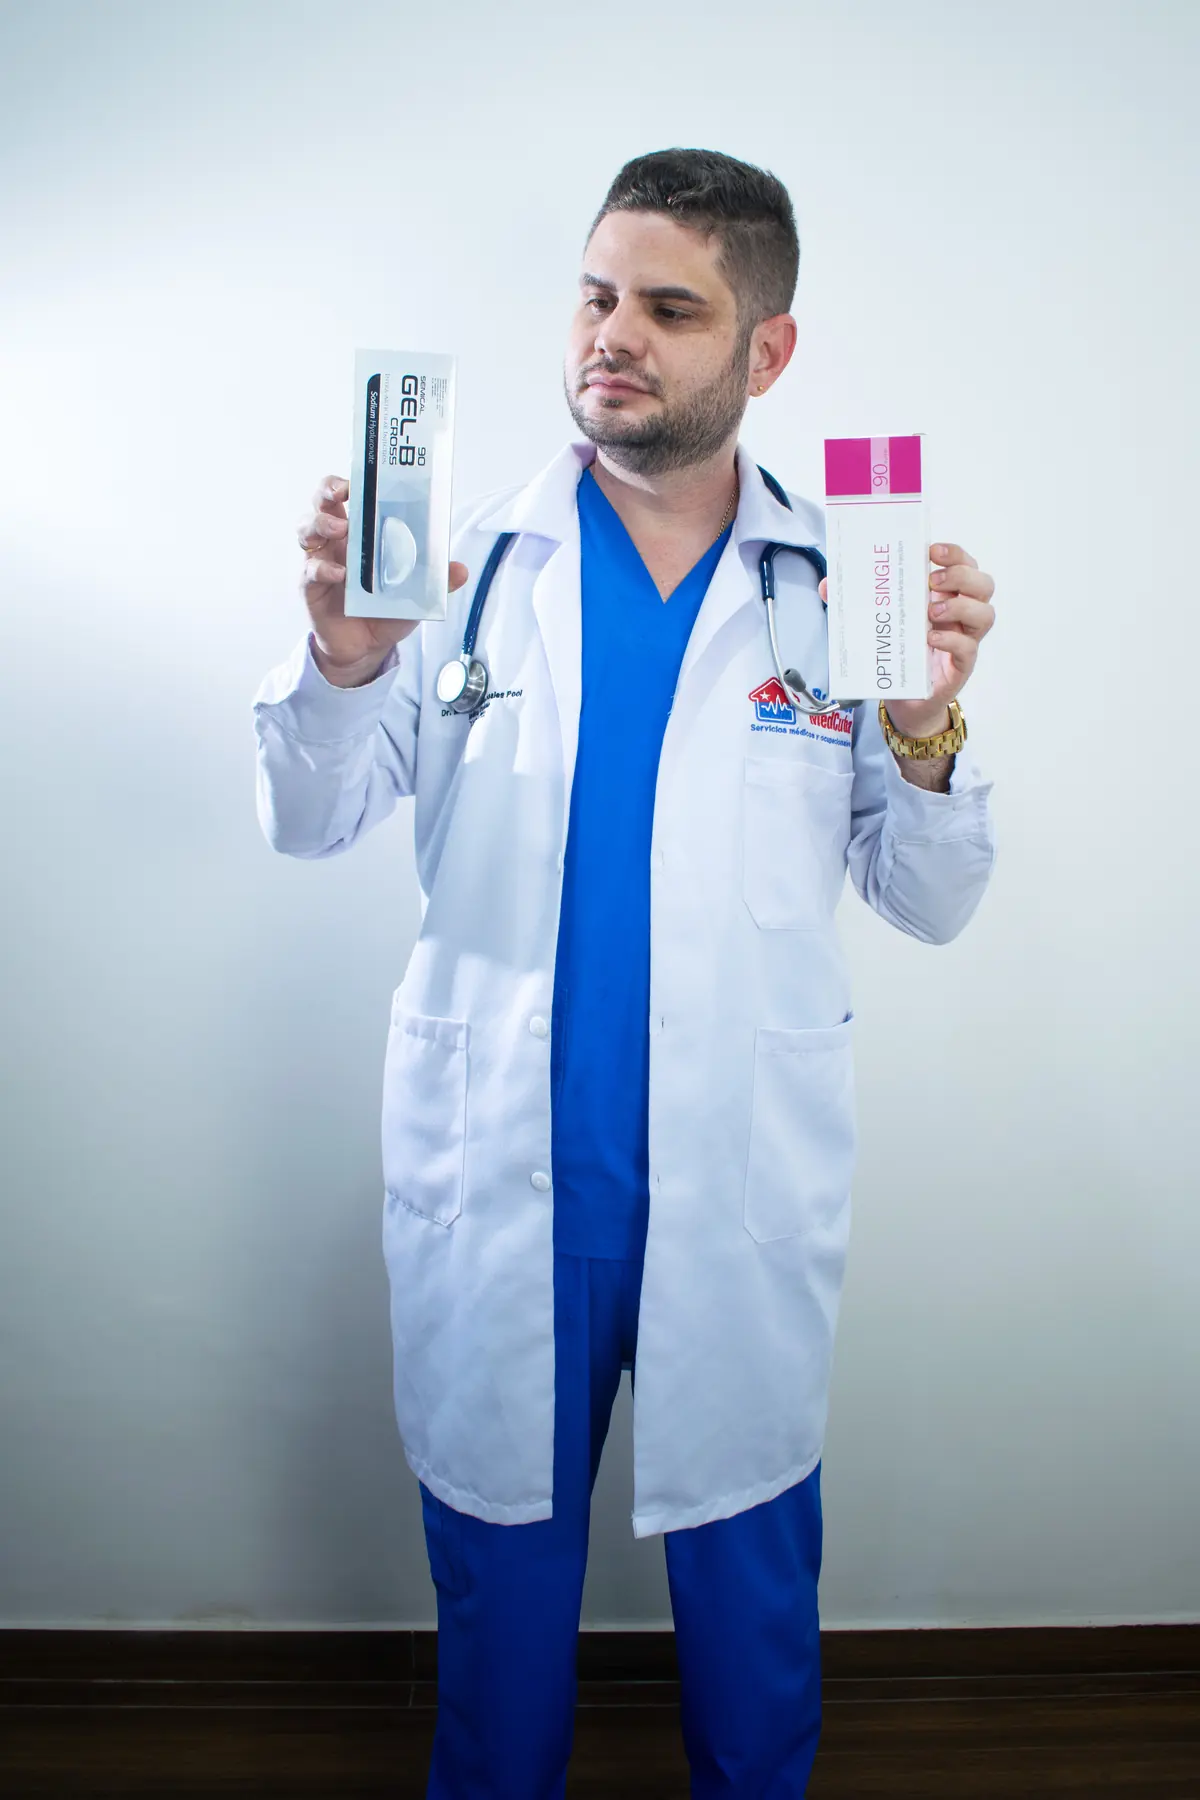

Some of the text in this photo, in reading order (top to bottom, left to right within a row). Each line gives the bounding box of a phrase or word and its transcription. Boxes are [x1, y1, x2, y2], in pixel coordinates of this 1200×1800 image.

[368, 390, 378, 465] Sodium Hyaluronate
[399, 374, 418, 466] GEL-B
[389, 418, 398, 466] CROSS
[418, 447, 426, 467] 90
[872, 464, 888, 487] 90
[874, 544, 892, 690] OPTIVISC SINGLE
[441, 709, 452, 717] Dr.
[506, 689, 523, 698] Pool
[750, 724, 787, 734] Servicios
[789, 727, 815, 738] médicos
